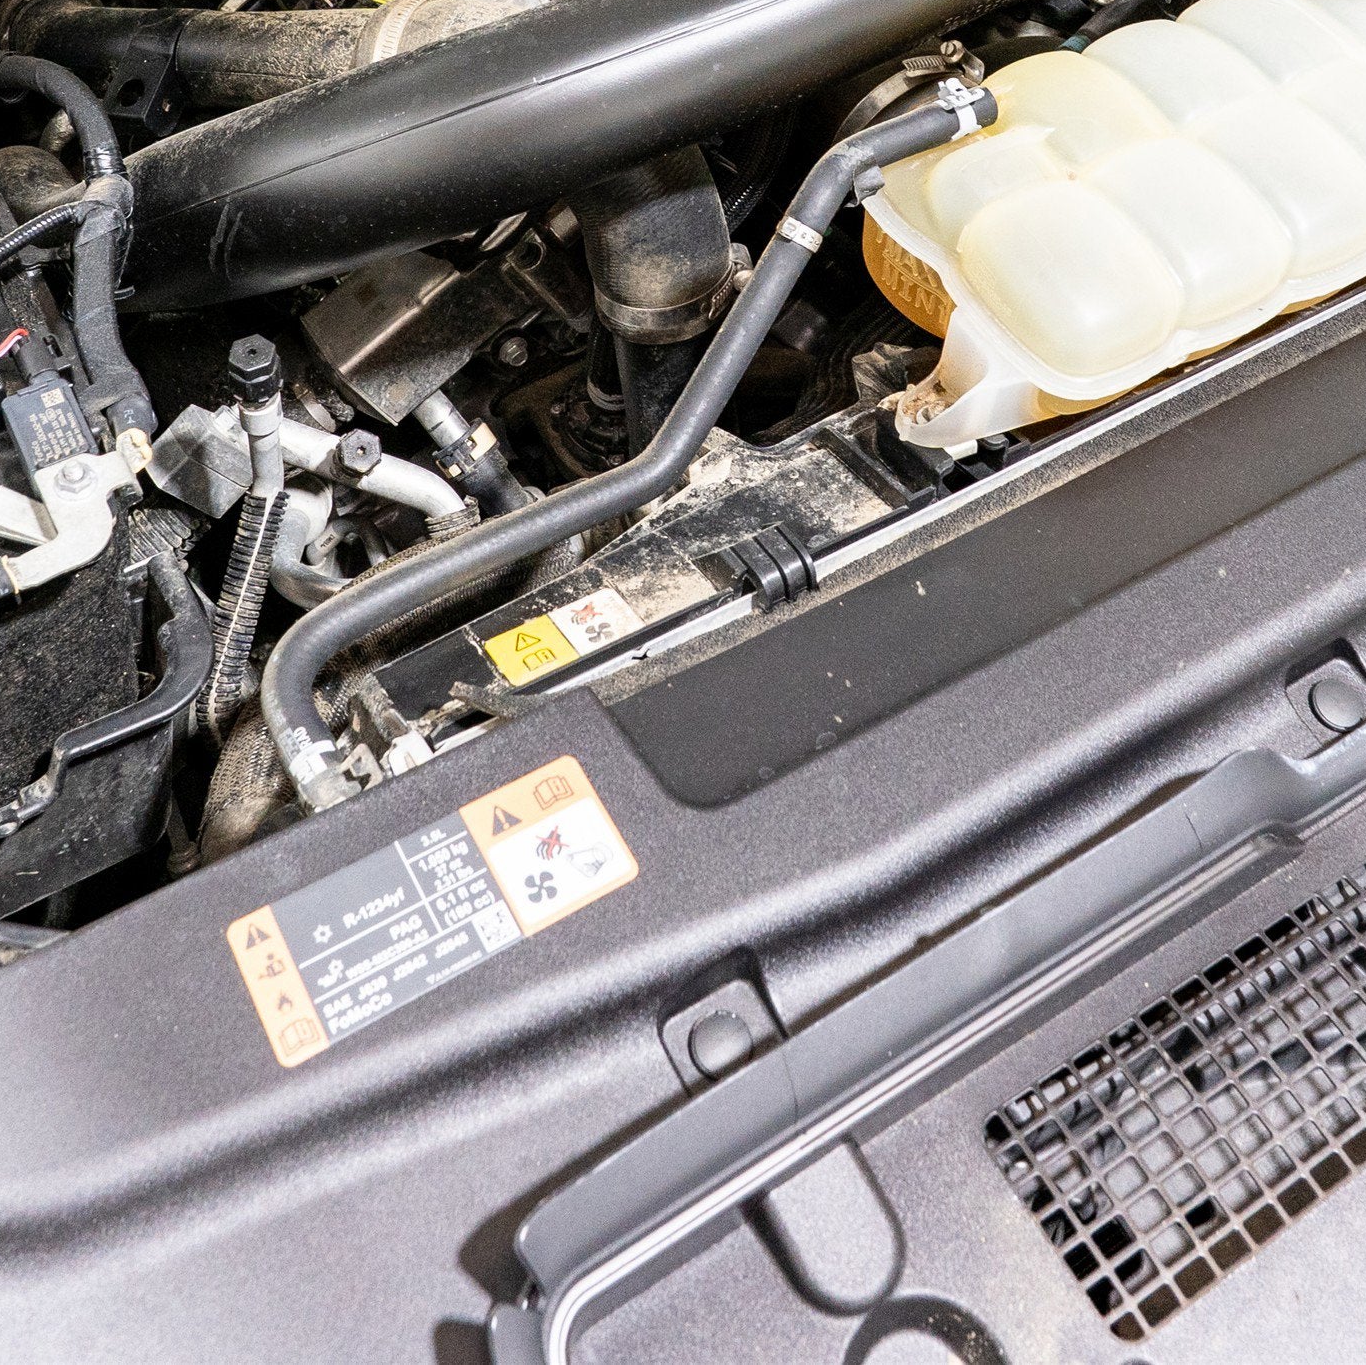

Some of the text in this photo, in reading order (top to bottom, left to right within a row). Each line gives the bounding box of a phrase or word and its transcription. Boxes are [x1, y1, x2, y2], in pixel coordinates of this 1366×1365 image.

[451, 841, 469, 856] kg
[343, 887, 405, 929] R-1234yf
[437, 891, 456, 911] 6.1
[389, 915, 423, 940] PAG
[323, 994, 352, 1017] SAE
[328, 993, 392, 1033] FoMoCo
